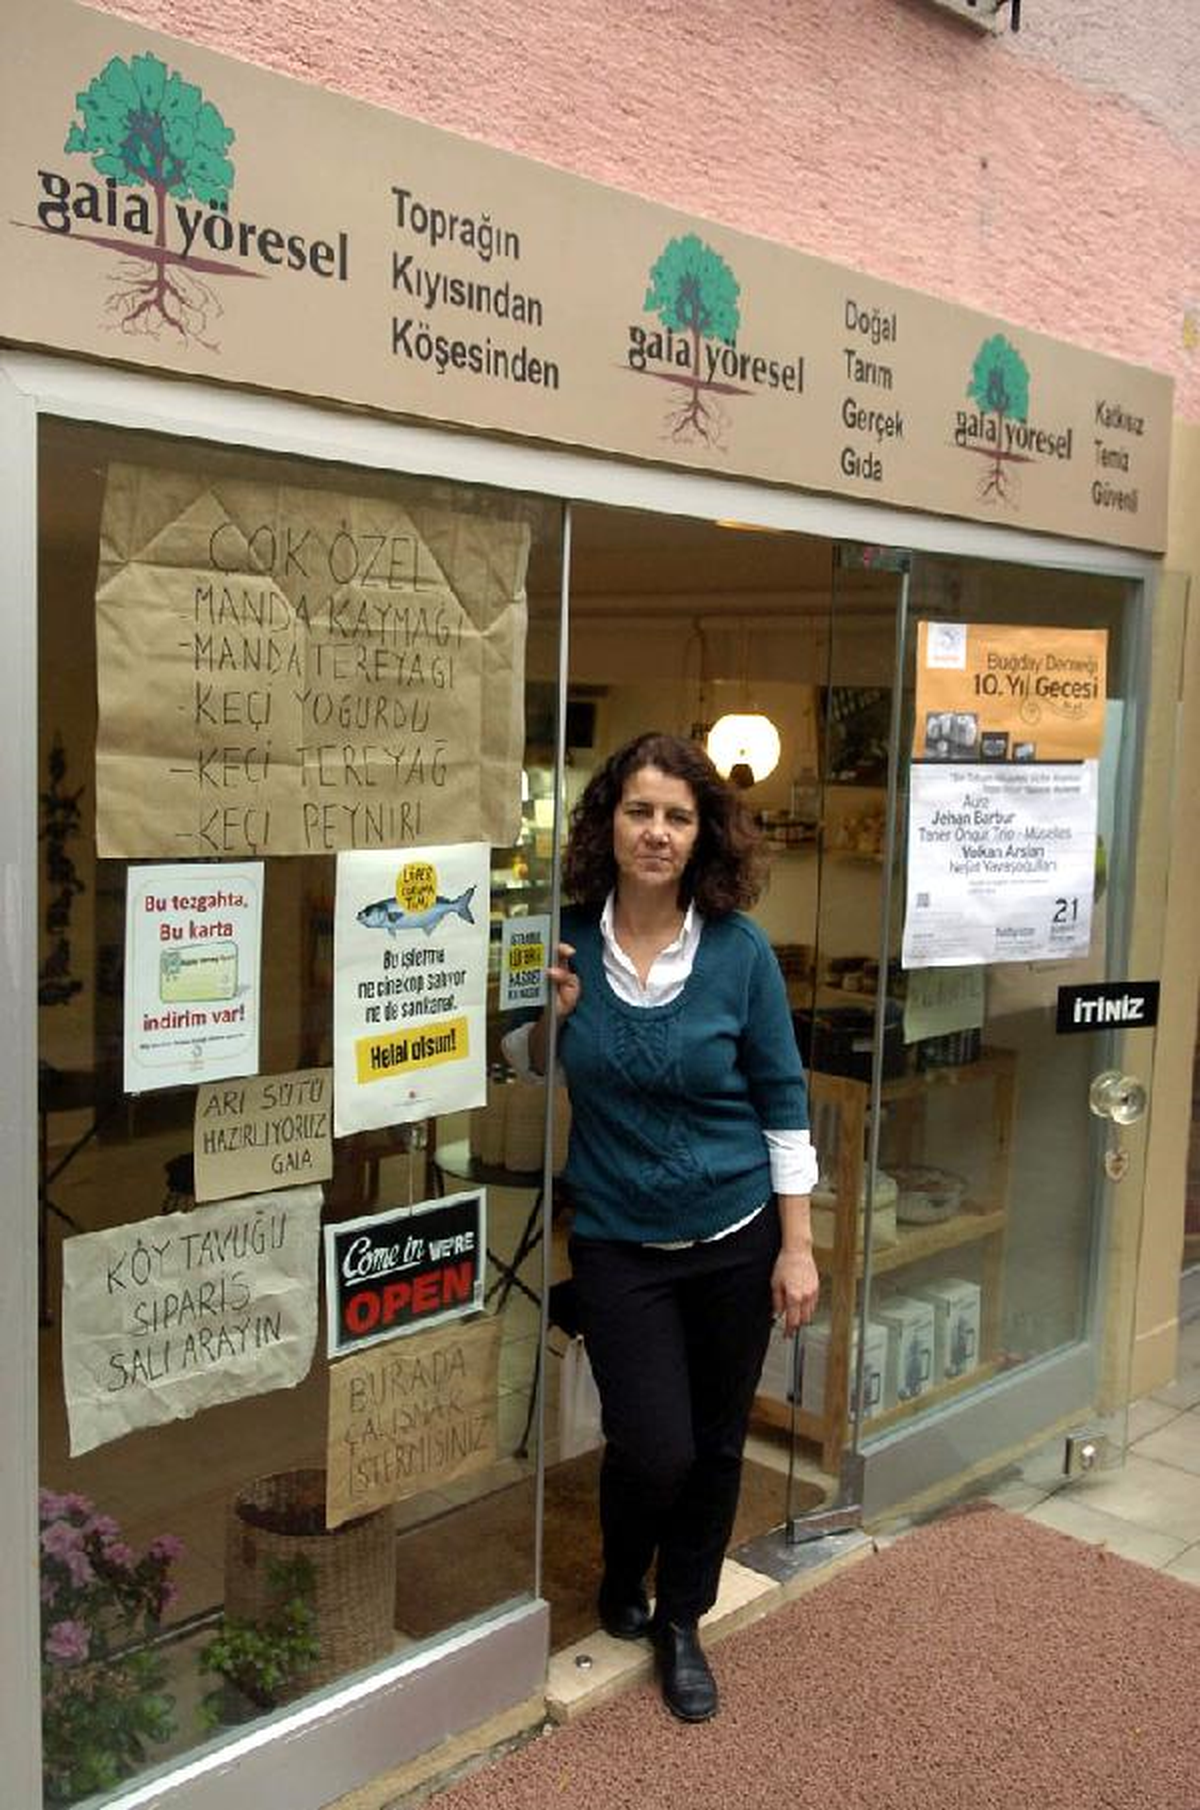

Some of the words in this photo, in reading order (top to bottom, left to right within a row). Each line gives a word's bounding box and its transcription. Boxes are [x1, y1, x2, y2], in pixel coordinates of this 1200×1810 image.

[37, 170, 153, 235] gaia
[176, 200, 348, 280] yöresel
[392, 187, 520, 262] Toprağın
[393, 252, 542, 326] Kıyısından
[845, 300, 897, 344] Doğal
[392, 318, 559, 389] Köşesinden
[628, 325, 691, 371] gaia
[706, 340, 804, 394] yöresel
[845, 349, 893, 391] Tarım
[842, 401, 903, 441] Gerçek
[955, 411, 997, 447] gaia
[1005, 418, 1072, 461] yöresel
[1095, 400, 1144, 436] Katkısız
[841, 448, 883, 482] Gıda
[1094, 439, 1129, 472] Temiz
[1092, 480, 1138, 514] Güvenli
[975, 674, 1003, 696] 10.
[1007, 675, 1030, 698] Yıl
[1036, 676, 1099, 699] Gecesi
[931, 811, 971, 826] Jehan
[145, 895, 167, 912] Bu
[1053, 897, 1079, 923] 21
[160, 923, 183, 941] Bu
[189, 921, 233, 939] karta
[383, 950, 398, 970] Bu
[358, 981, 374, 999] ne
[1073, 994, 1145, 1025] İTİNİZ
[143, 1010, 206, 1031] indirim
[212, 1003, 245, 1023] var!
[366, 1005, 381, 1023] ne
[384, 1001, 398, 1021] de
[371, 1040, 408, 1069] Helal
[412, 1028, 457, 1061] olsun!
[203, 1090, 245, 1118] ARI
[203, 1113, 327, 1154] HAZIRLIYORUZ
[180, 1211, 286, 1270] TAVUĞU
[342, 1236, 400, 1279] Come
[403, 1235, 424, 1263] in
[429, 1232, 475, 1261] WE'RE
[344, 1262, 474, 1334] OPEN
[107, 1341, 170, 1392] SALI
[183, 1311, 281, 1368] ARAYIN
[350, 1348, 466, 1413] BURADA
